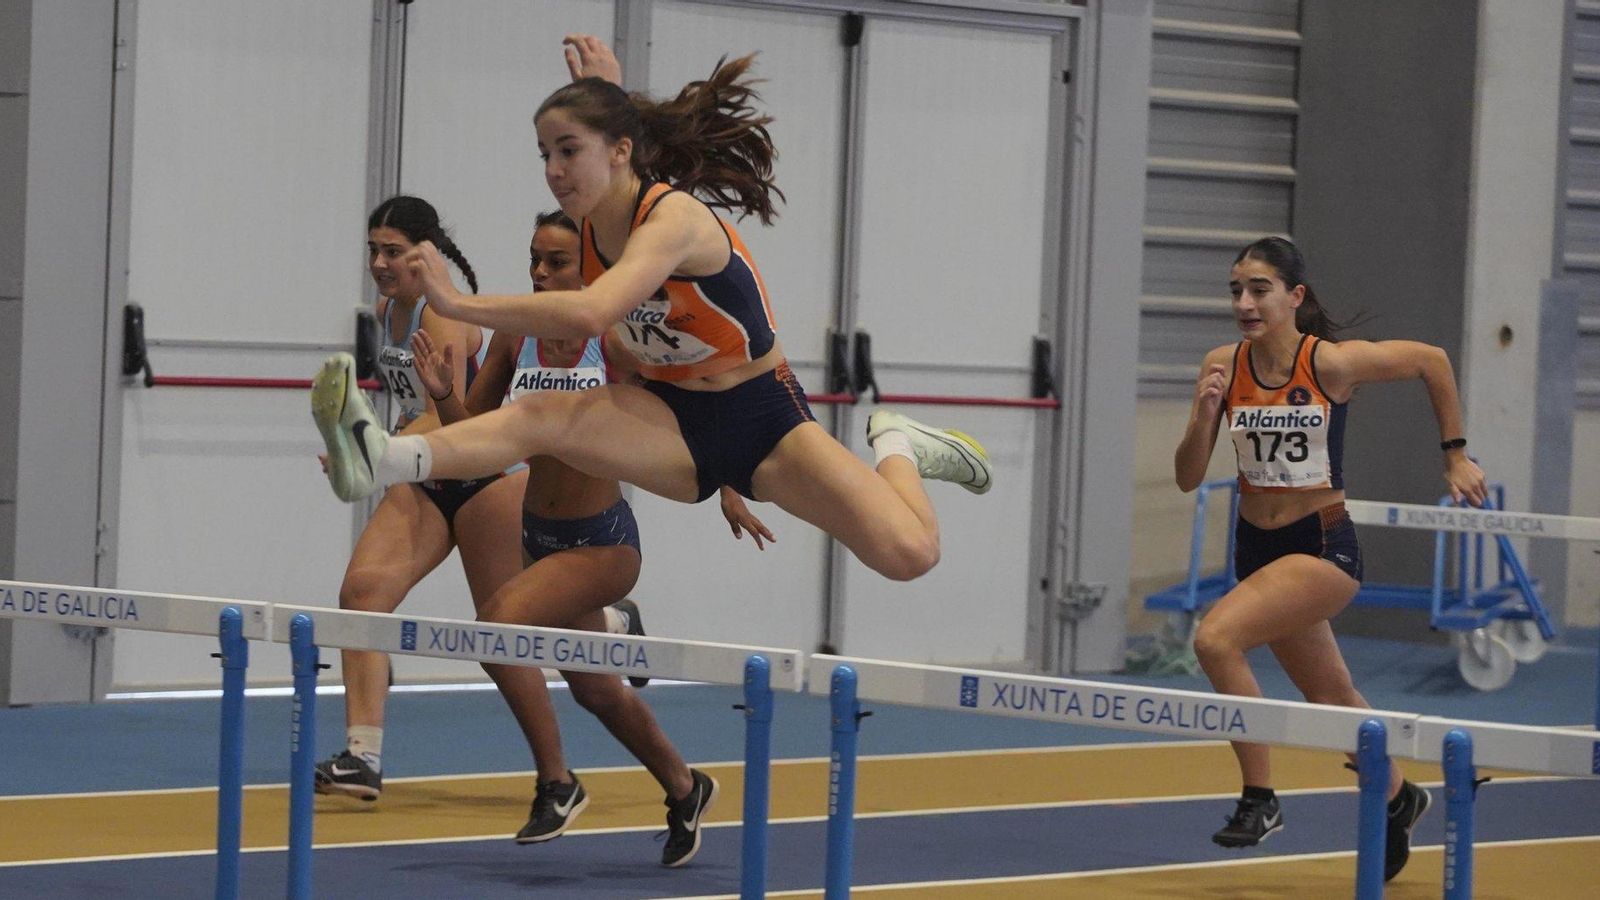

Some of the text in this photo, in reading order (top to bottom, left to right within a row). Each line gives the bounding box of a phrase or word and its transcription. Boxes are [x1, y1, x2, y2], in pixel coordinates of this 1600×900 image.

[515, 371, 600, 391] Atlántico
[1235, 409, 1323, 428] Atlántico
[1245, 431, 1309, 463] 173
[1407, 510, 1544, 533] XUNTA DE GALICIA
[22, 590, 48, 613] DE
[55, 592, 139, 621] GALICIA
[428, 626, 649, 669] XUNTA DE GALICIA
[992, 682, 1247, 734] XUNTA DE GALICIA
